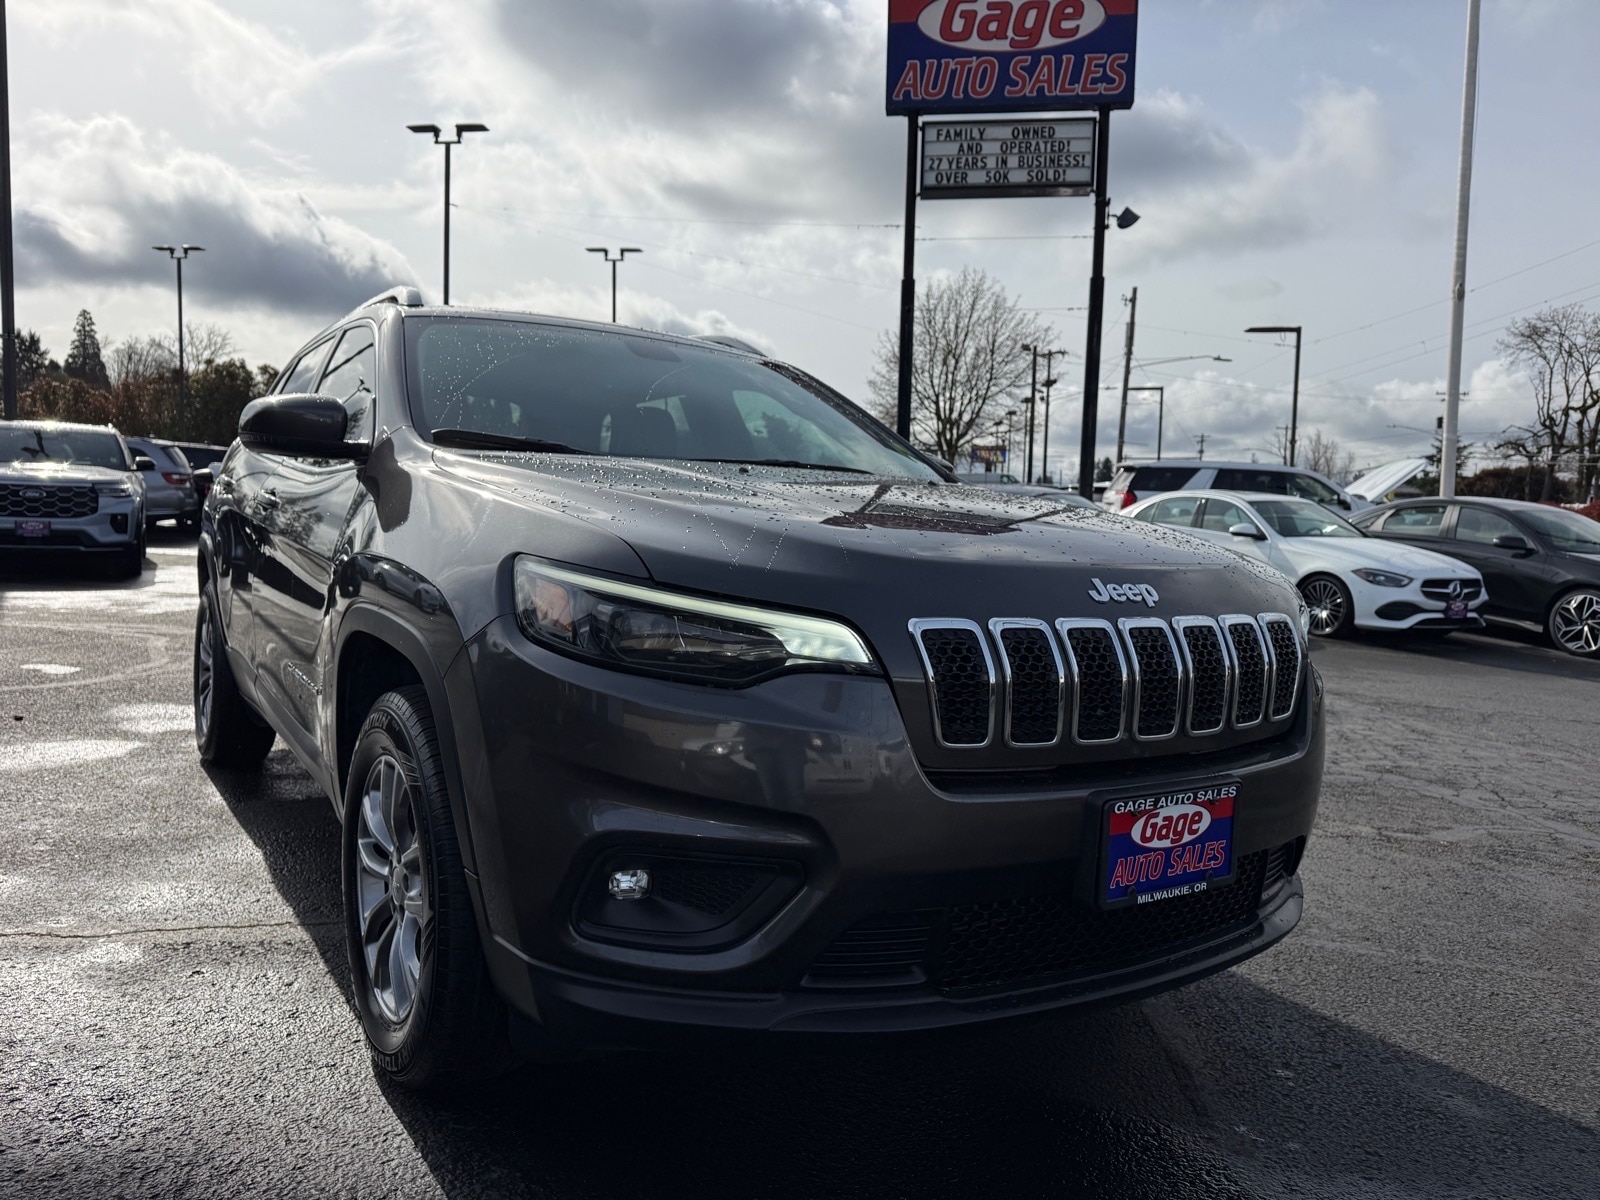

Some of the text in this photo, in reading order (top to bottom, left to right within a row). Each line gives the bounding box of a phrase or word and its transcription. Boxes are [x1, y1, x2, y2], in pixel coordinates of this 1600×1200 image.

[939, 0, 1086, 49] Gage
[892, 53, 1129, 100] AUTO SALES
[936, 126, 1056, 141] FAMILY OWNED
[957, 140, 1071, 155] AND OPERATED!
[928, 154, 1086, 170] 27 YEARS IN BUSINESS!
[935, 171, 968, 184] OVER
[1027, 169, 1066, 182] SOLD!
[1087, 577, 1160, 608] Jeep
[1114, 786, 1237, 814] GAGE AUTO SALES
[1139, 810, 1204, 844] Gage
[1110, 840, 1226, 889] AUTO SALES
[1194, 882, 1207, 892] OR
